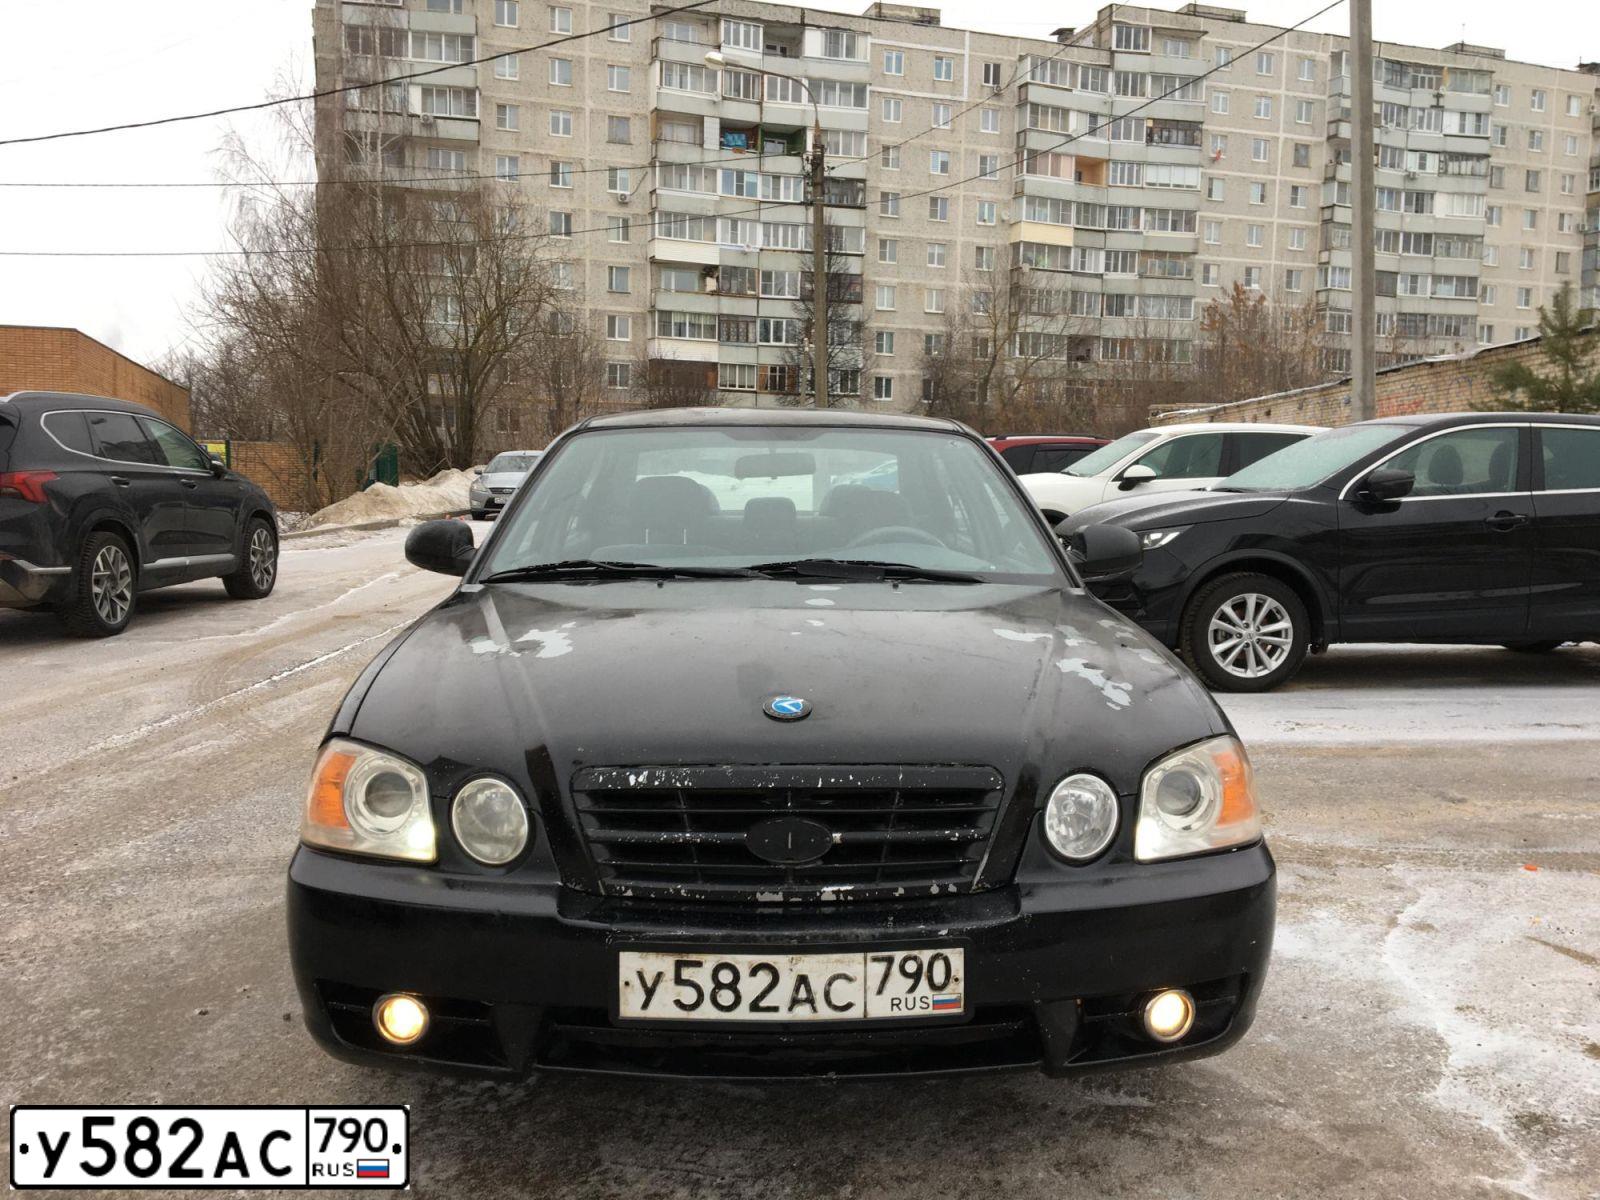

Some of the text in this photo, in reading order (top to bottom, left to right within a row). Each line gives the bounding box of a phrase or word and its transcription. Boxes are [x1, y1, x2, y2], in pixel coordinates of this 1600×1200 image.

[636, 952, 952, 1014] У582АС 790
[890, 996, 931, 1012] RUS
